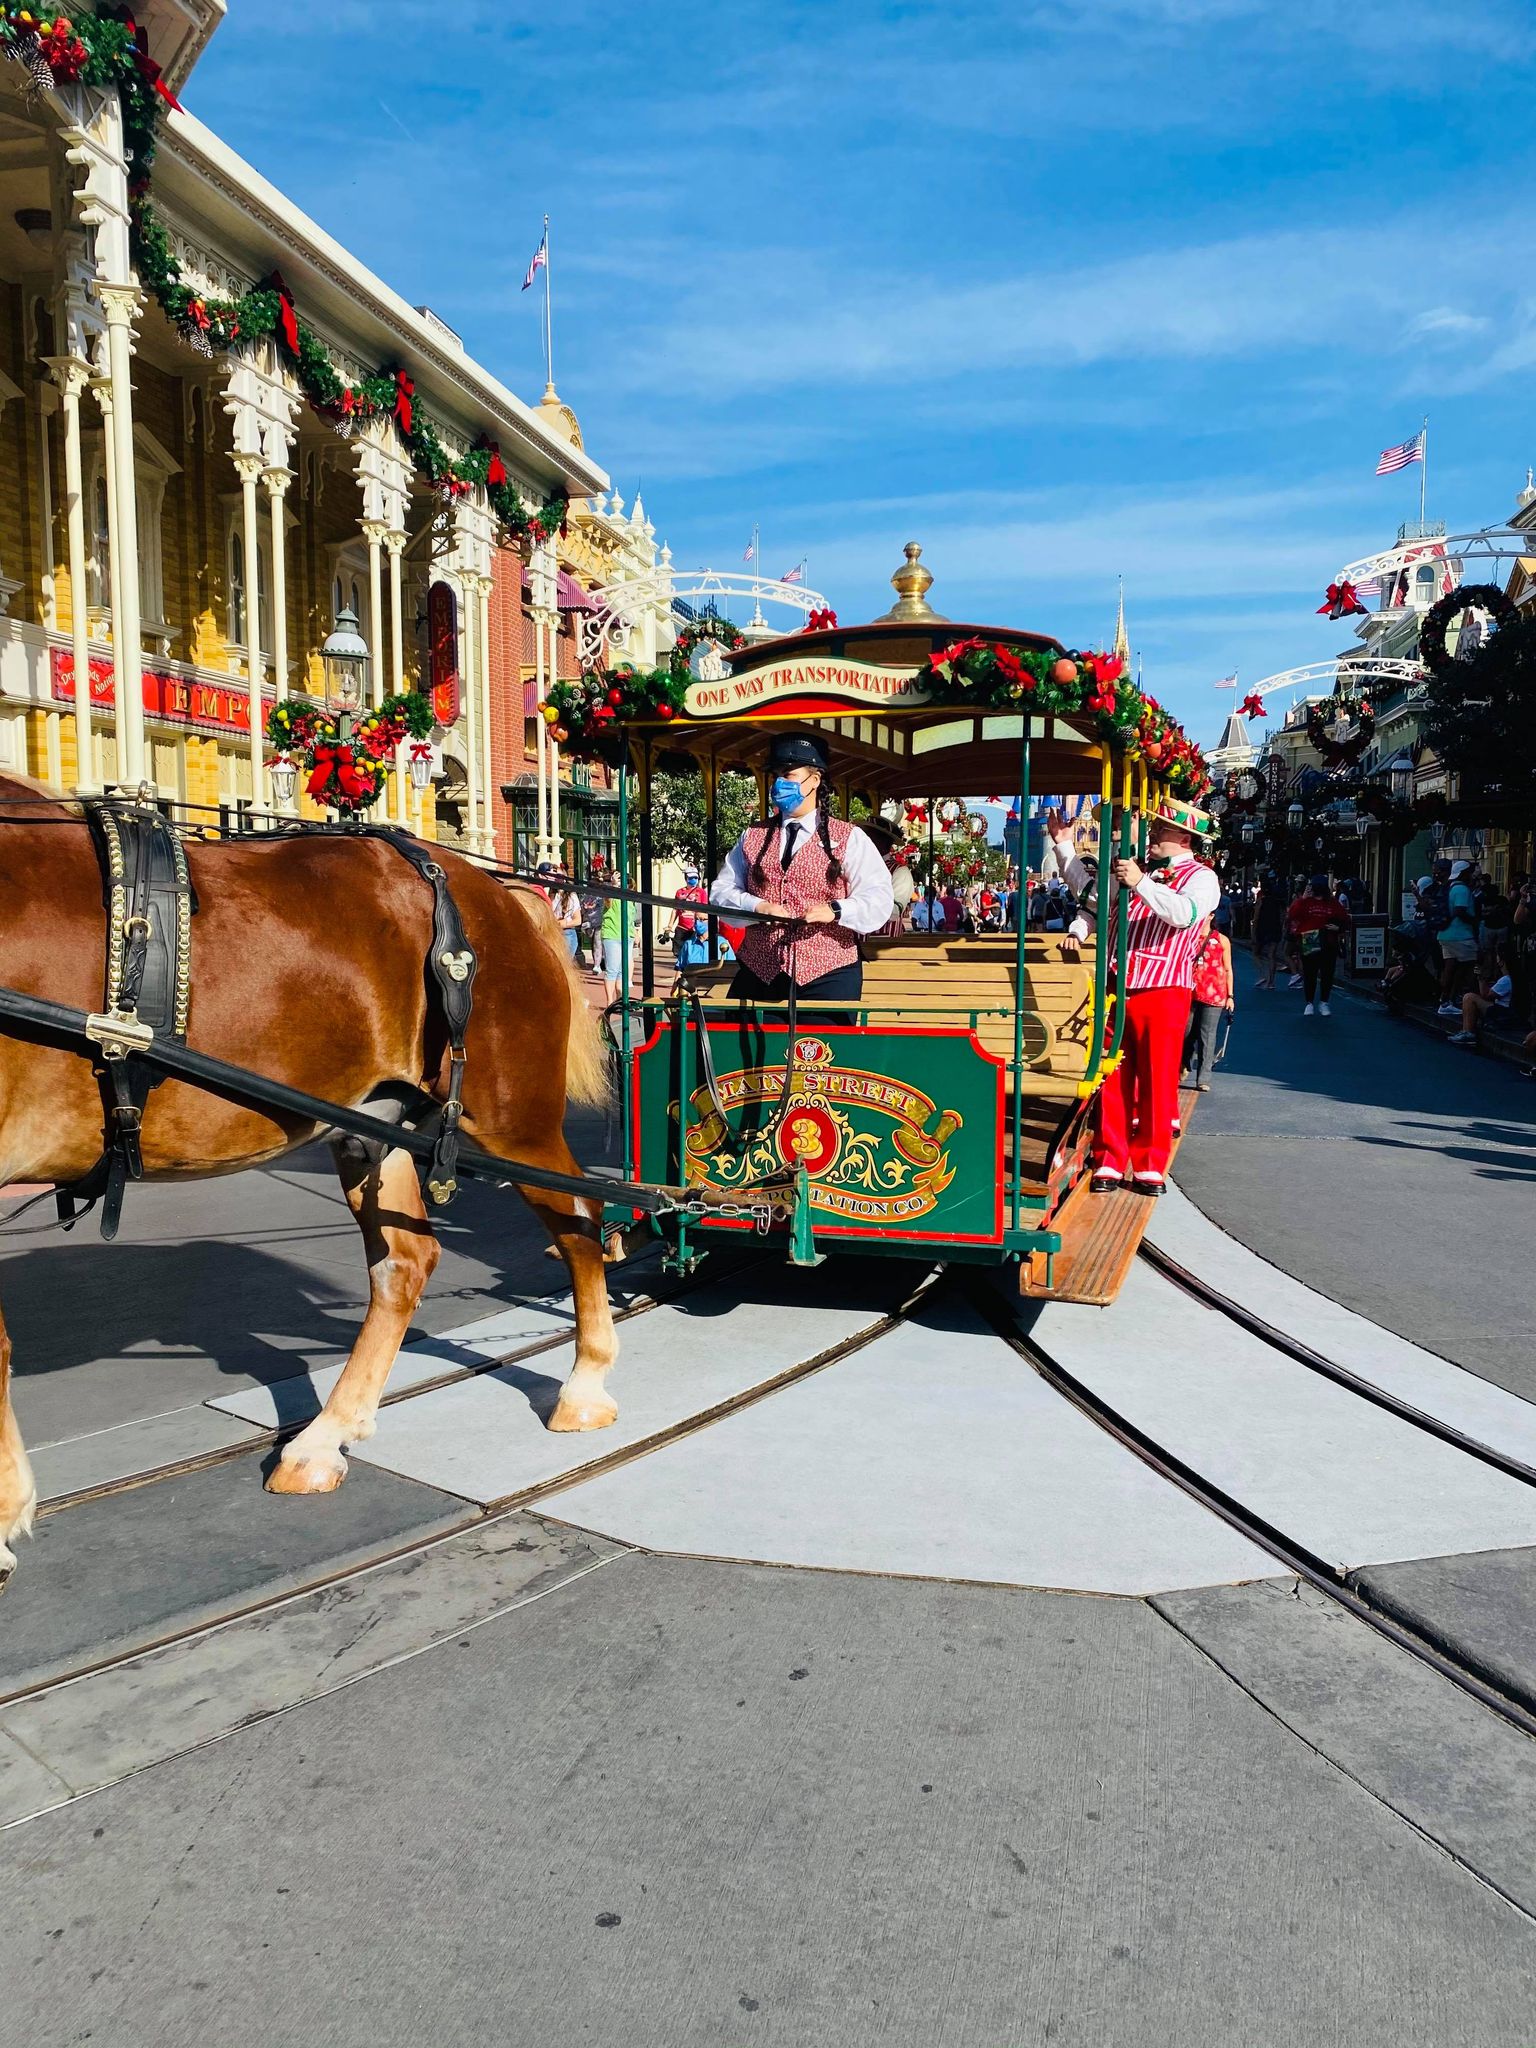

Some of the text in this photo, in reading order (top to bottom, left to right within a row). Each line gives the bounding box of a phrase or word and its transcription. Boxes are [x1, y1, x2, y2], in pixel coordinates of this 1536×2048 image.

[434, 597, 451, 710] EMPORIUM
[695, 665, 921, 708] ONE WAY TRANSPORTATION
[718, 1073, 916, 1112] MAIN STREET
[791, 1118, 824, 1160] 3
[894, 1196, 928, 1216] CO.
